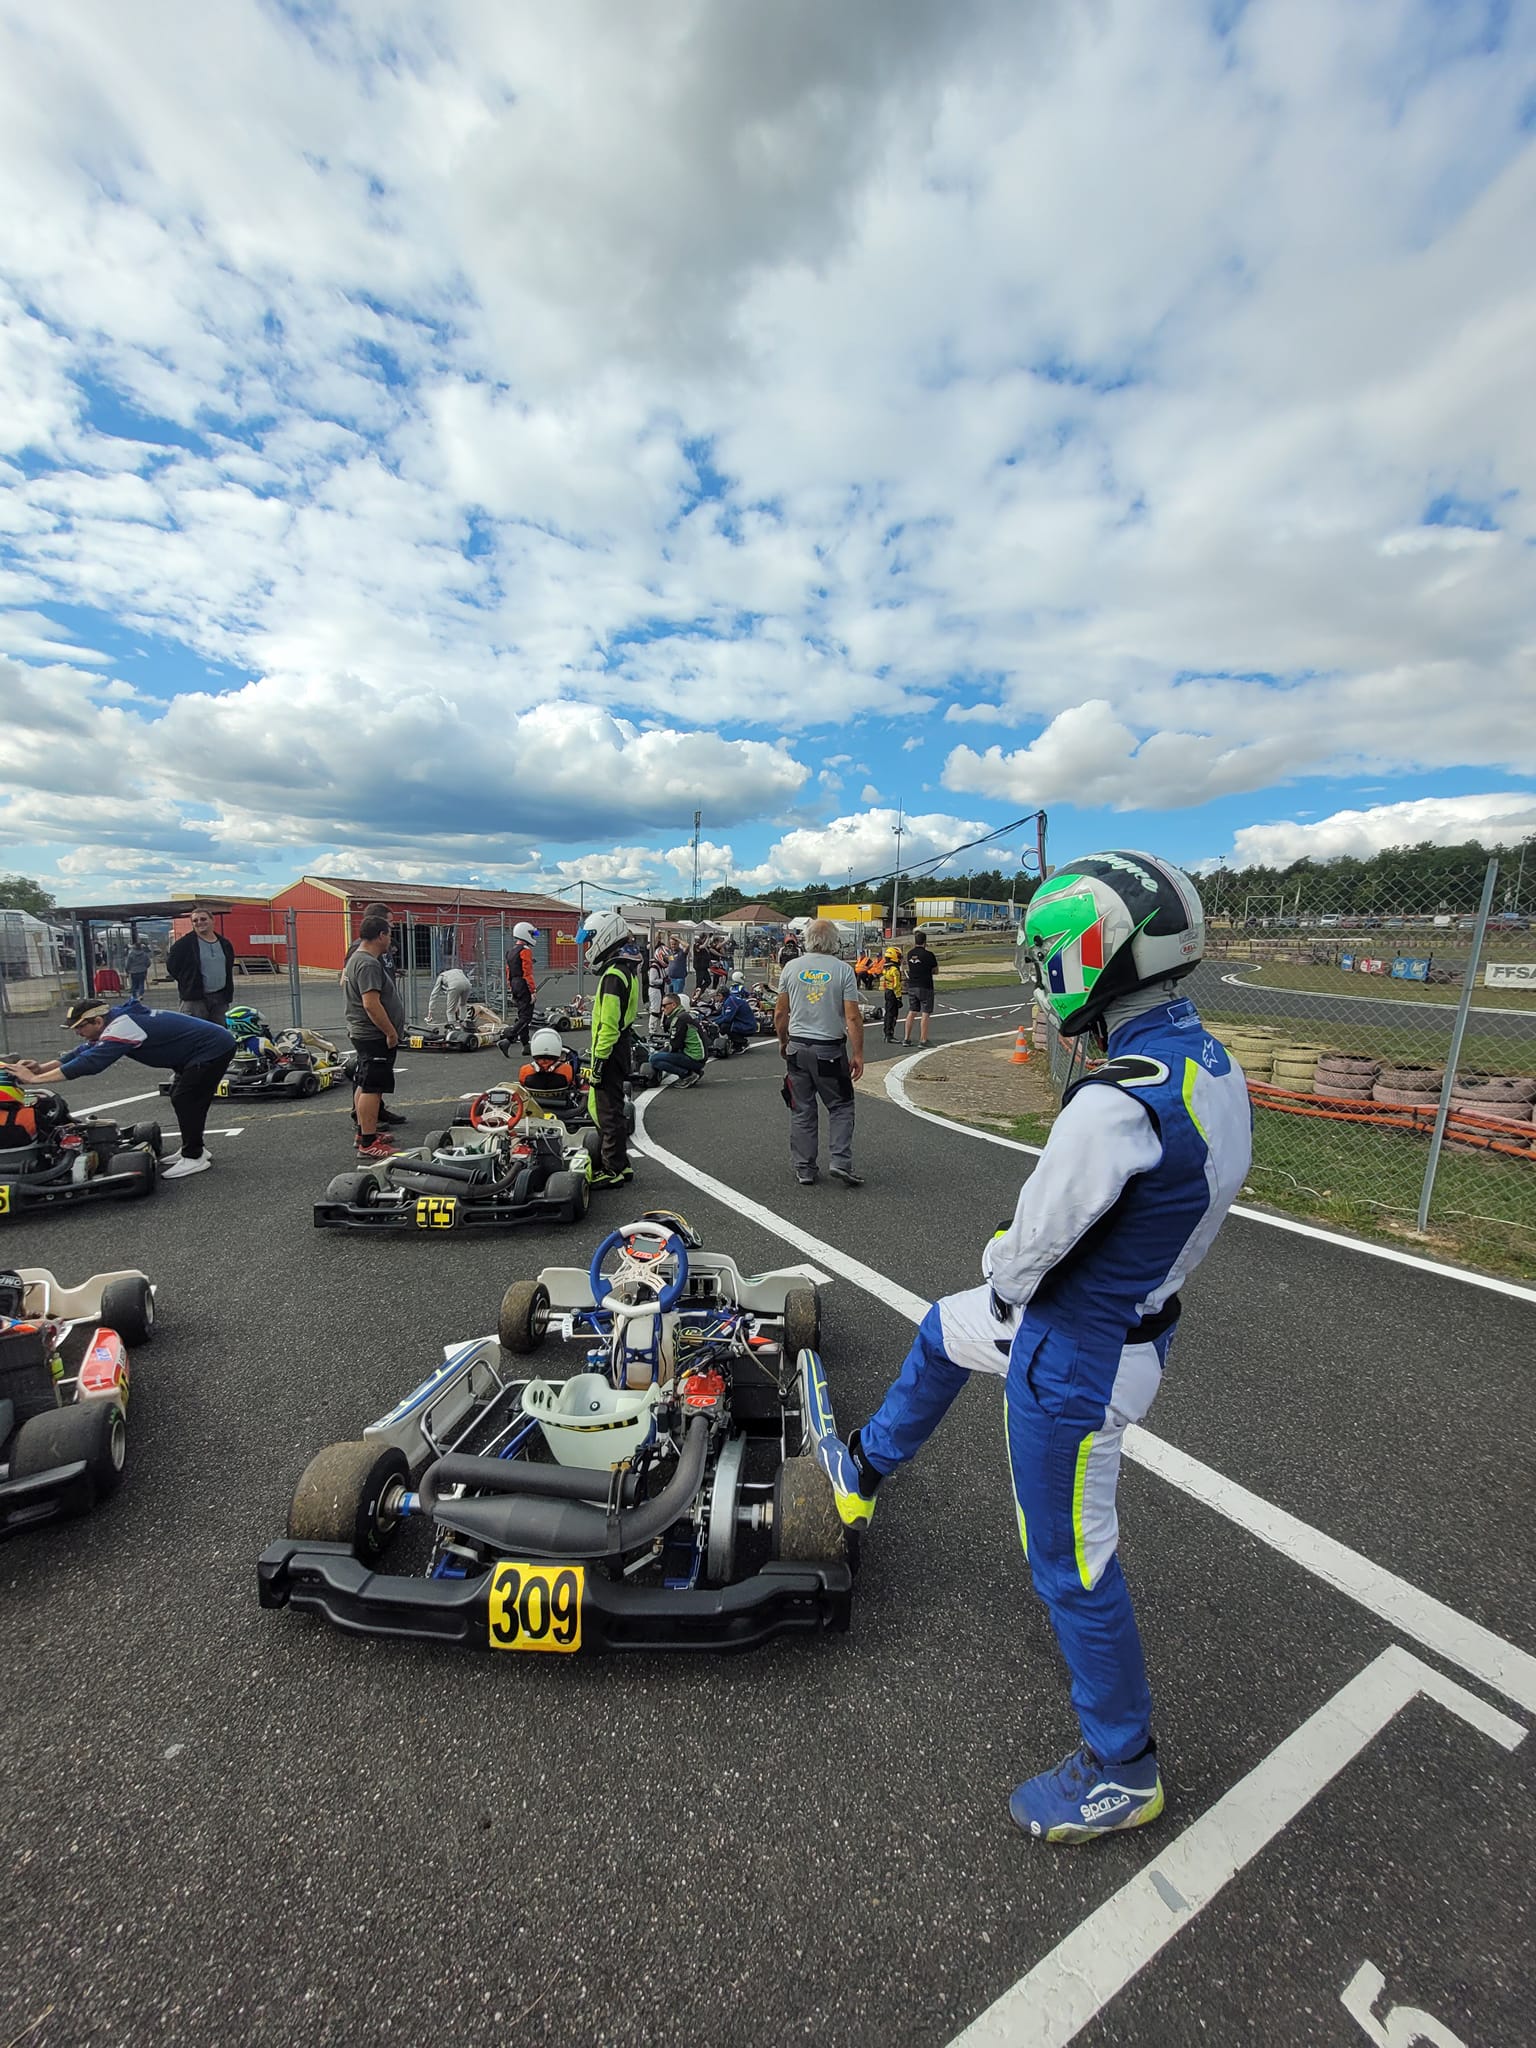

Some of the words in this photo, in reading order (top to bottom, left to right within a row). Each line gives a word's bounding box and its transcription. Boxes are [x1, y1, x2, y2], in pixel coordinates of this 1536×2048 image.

[417, 1199, 455, 1227] 325
[492, 1568, 578, 1645] 309
[1080, 1794, 1130, 1820] sparco
